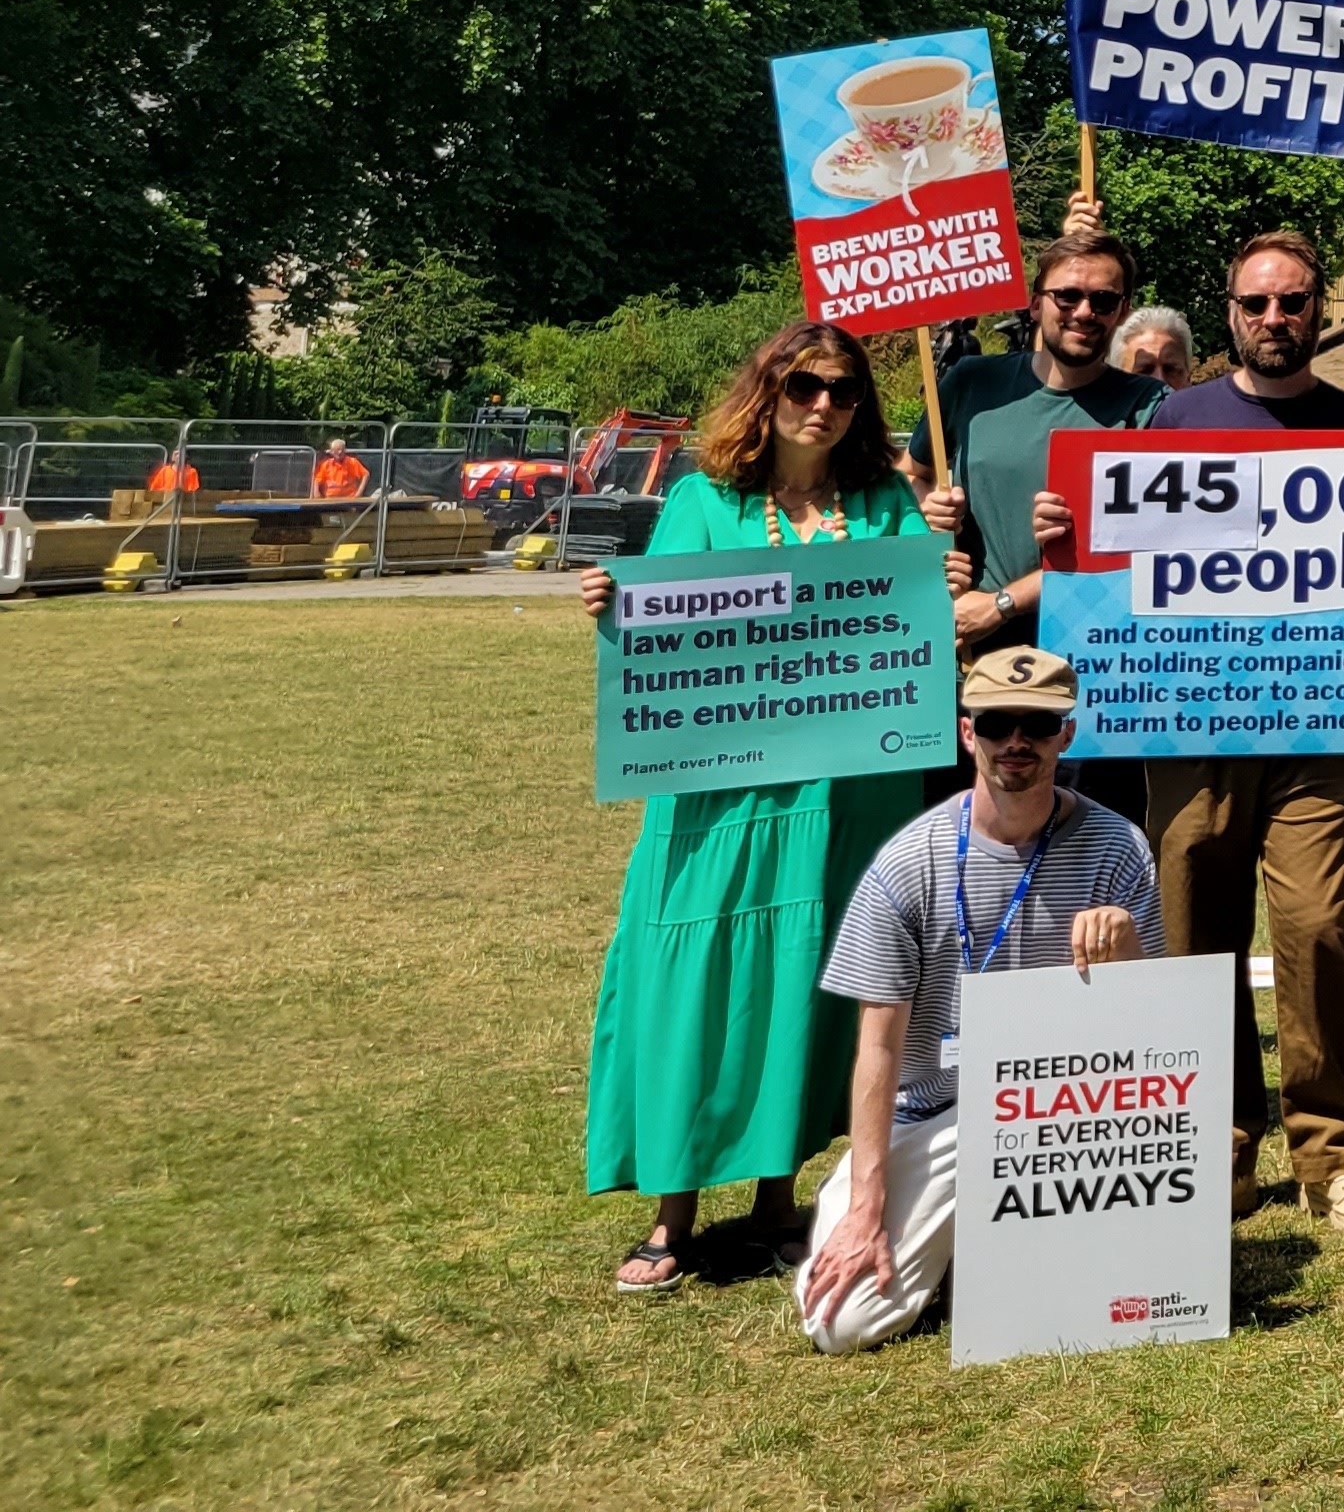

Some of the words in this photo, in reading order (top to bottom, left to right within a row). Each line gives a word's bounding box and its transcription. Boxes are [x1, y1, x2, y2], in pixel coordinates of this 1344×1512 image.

[811, 224, 925, 265] BREWED
[928, 208, 999, 238] WITH
[817, 232, 1004, 295] WORKER
[821, 262, 1012, 320] EXPLOITATION!
[623, 591, 634, 618] I
[644, 580, 787, 619] support
[796, 584, 815, 603] a
[824, 576, 894, 601] new
[623, 630, 686, 656] law
[694, 628, 737, 650] on
[746, 612, 911, 645] business,
[1087, 622, 1137, 644] and
[1144, 622, 1265, 646] counting
[623, 664, 745, 694] human
[754, 649, 860, 684] rights
[869, 640, 931, 670] and
[1008, 655, 1036, 684] S
[1067, 653, 1114, 674] law
[1120, 652, 1221, 676] holding
[622, 705, 684, 732] the
[693, 680, 919, 726] environment
[1087, 682, 1169, 708] public
[1175, 681, 1263, 703] sector
[1270, 681, 1298, 701] to
[1096, 712, 1167, 733] harm
[1175, 712, 1202, 732] to
[1209, 710, 1300, 735] people
[622, 761, 675, 776] Planet
[679, 757, 714, 768] over
[717, 750, 764, 765] Profit
[1001, 899, 1021, 929] TENANT
[996, 1050, 1134, 1082] FREEDOM
[1143, 1047, 1199, 1069] from
[995, 1072, 1199, 1122] SLAVERY
[993, 1129, 1029, 1151] for
[1038, 1112, 1198, 1146] EVERYONE,
[993, 1140, 1198, 1179] EVERYWHERE,
[991, 1168, 1195, 1222] ALWAYS
[1151, 1292, 1187, 1306] anti-
[1151, 1304, 1208, 1319] slavery
